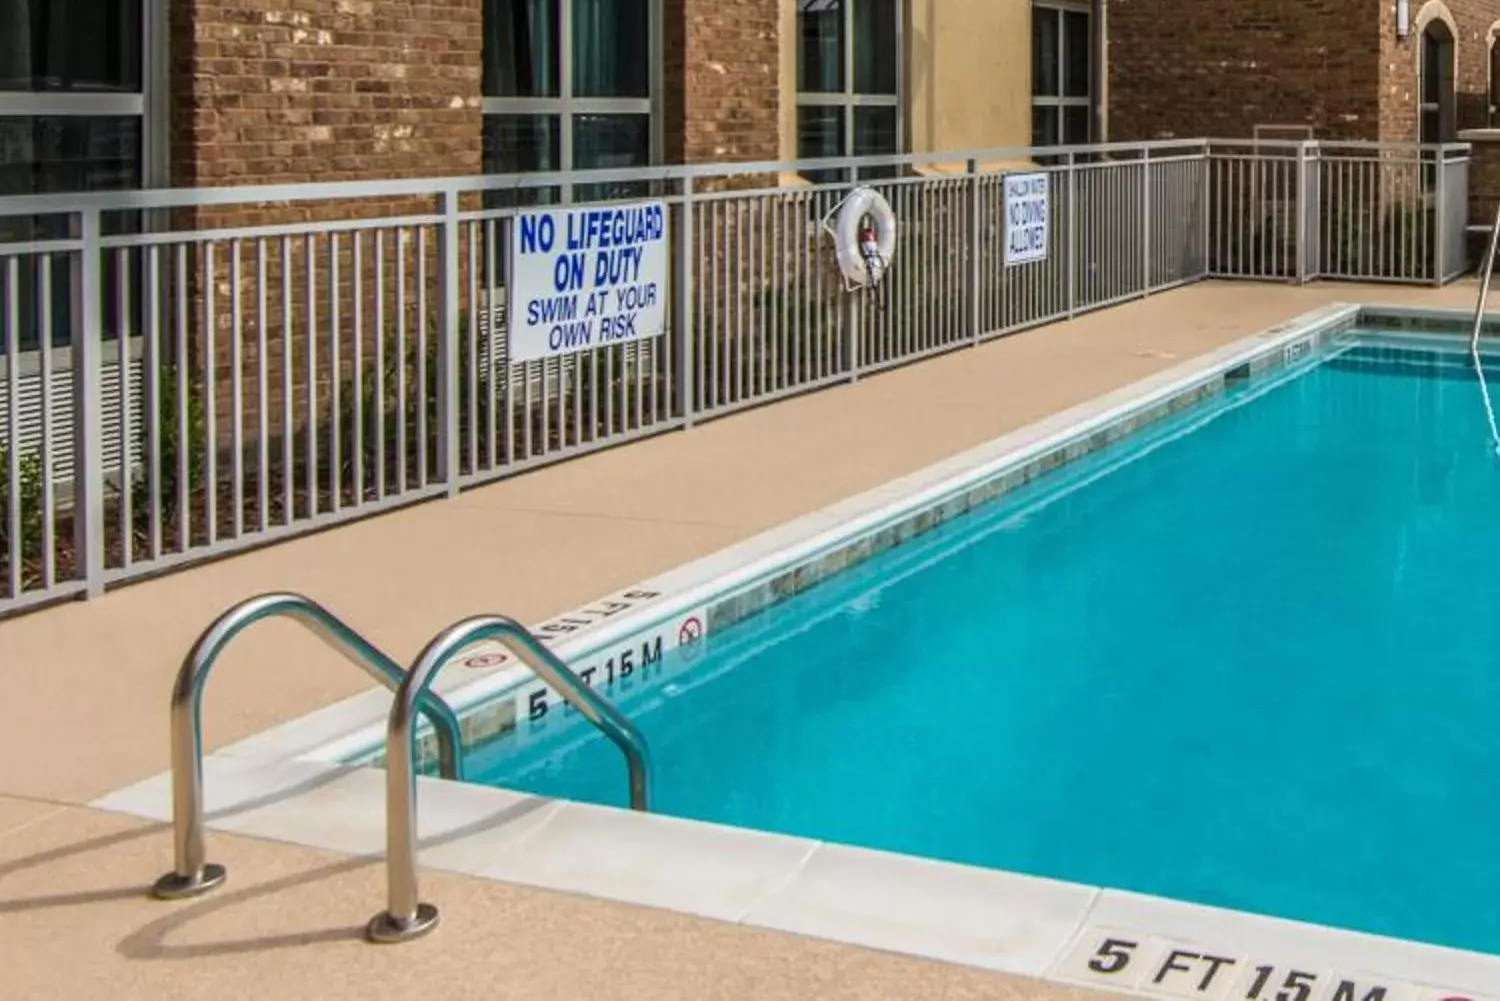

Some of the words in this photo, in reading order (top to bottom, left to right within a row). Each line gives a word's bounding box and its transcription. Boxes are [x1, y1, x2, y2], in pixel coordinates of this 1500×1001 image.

[520, 214, 554, 254] NO
[567, 205, 663, 250] LIFEGUARD
[554, 253, 585, 292] ON
[595, 246, 643, 287] DUTY
[527, 296, 577, 326] SWIM
[585, 291, 609, 317] AT
[616, 282, 657, 311] YOUR
[549, 320, 592, 350] OWN
[600, 312, 637, 341] RISK
[528, 688, 548, 721] 5
[642, 635, 663, 668] M
[1087, 938, 1139, 974] 5
[1152, 949, 1236, 992] FT
[1334, 980, 1388, 1001] M
